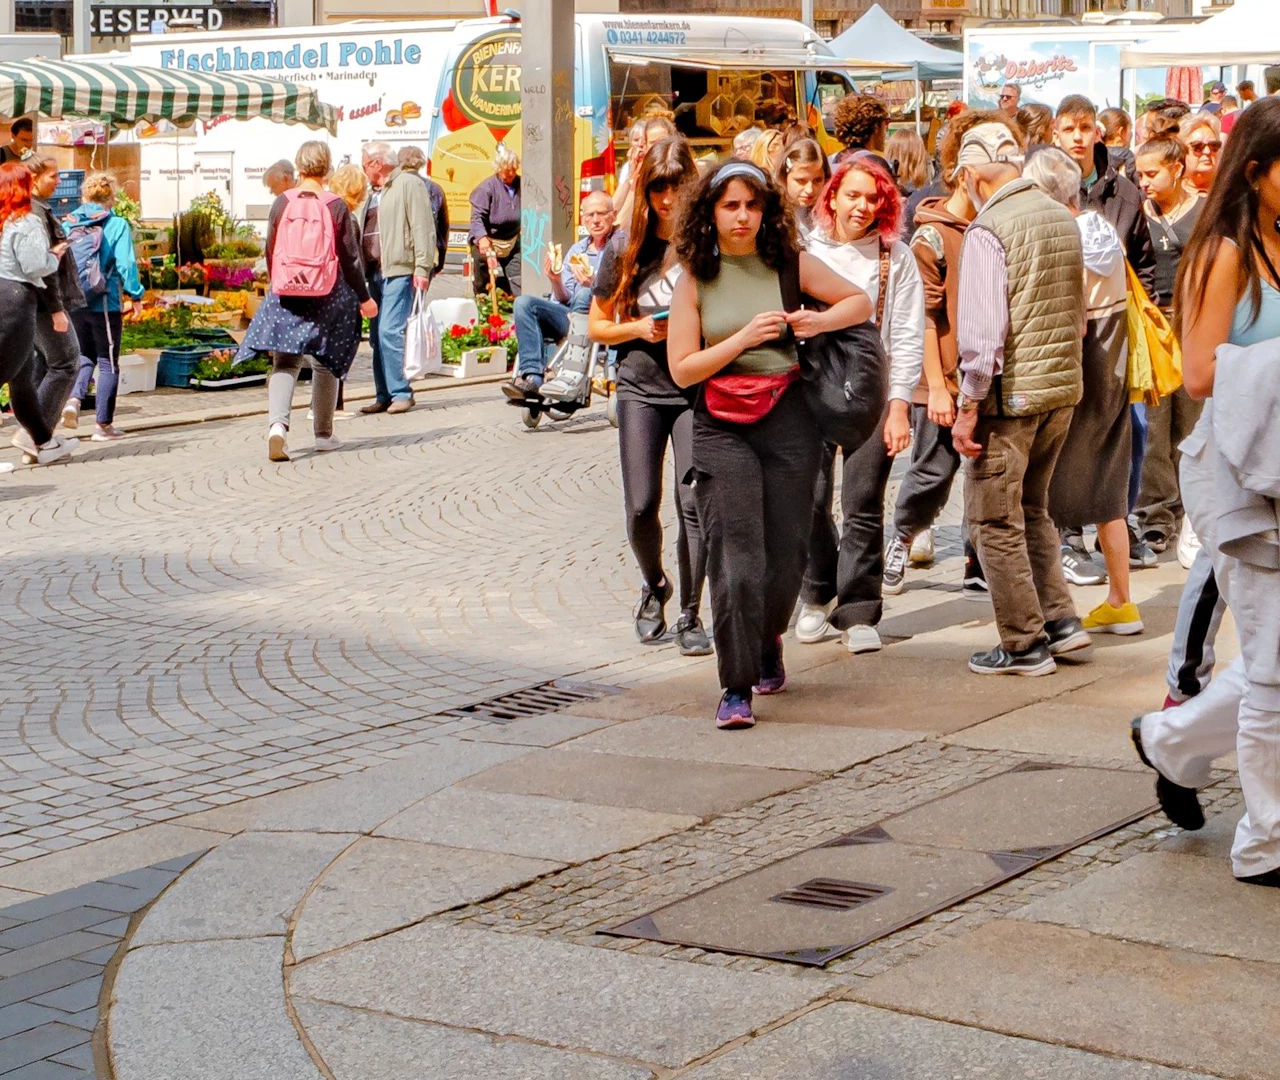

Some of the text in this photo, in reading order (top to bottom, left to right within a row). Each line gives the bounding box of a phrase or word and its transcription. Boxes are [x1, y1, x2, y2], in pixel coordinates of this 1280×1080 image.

[620, 31, 686, 44] 0341 4244572
[161, 39, 422, 73] Fischhandel Pohle
[326, 70, 378, 81] Marinaden
[1005, 55, 1077, 80] Däberitz
